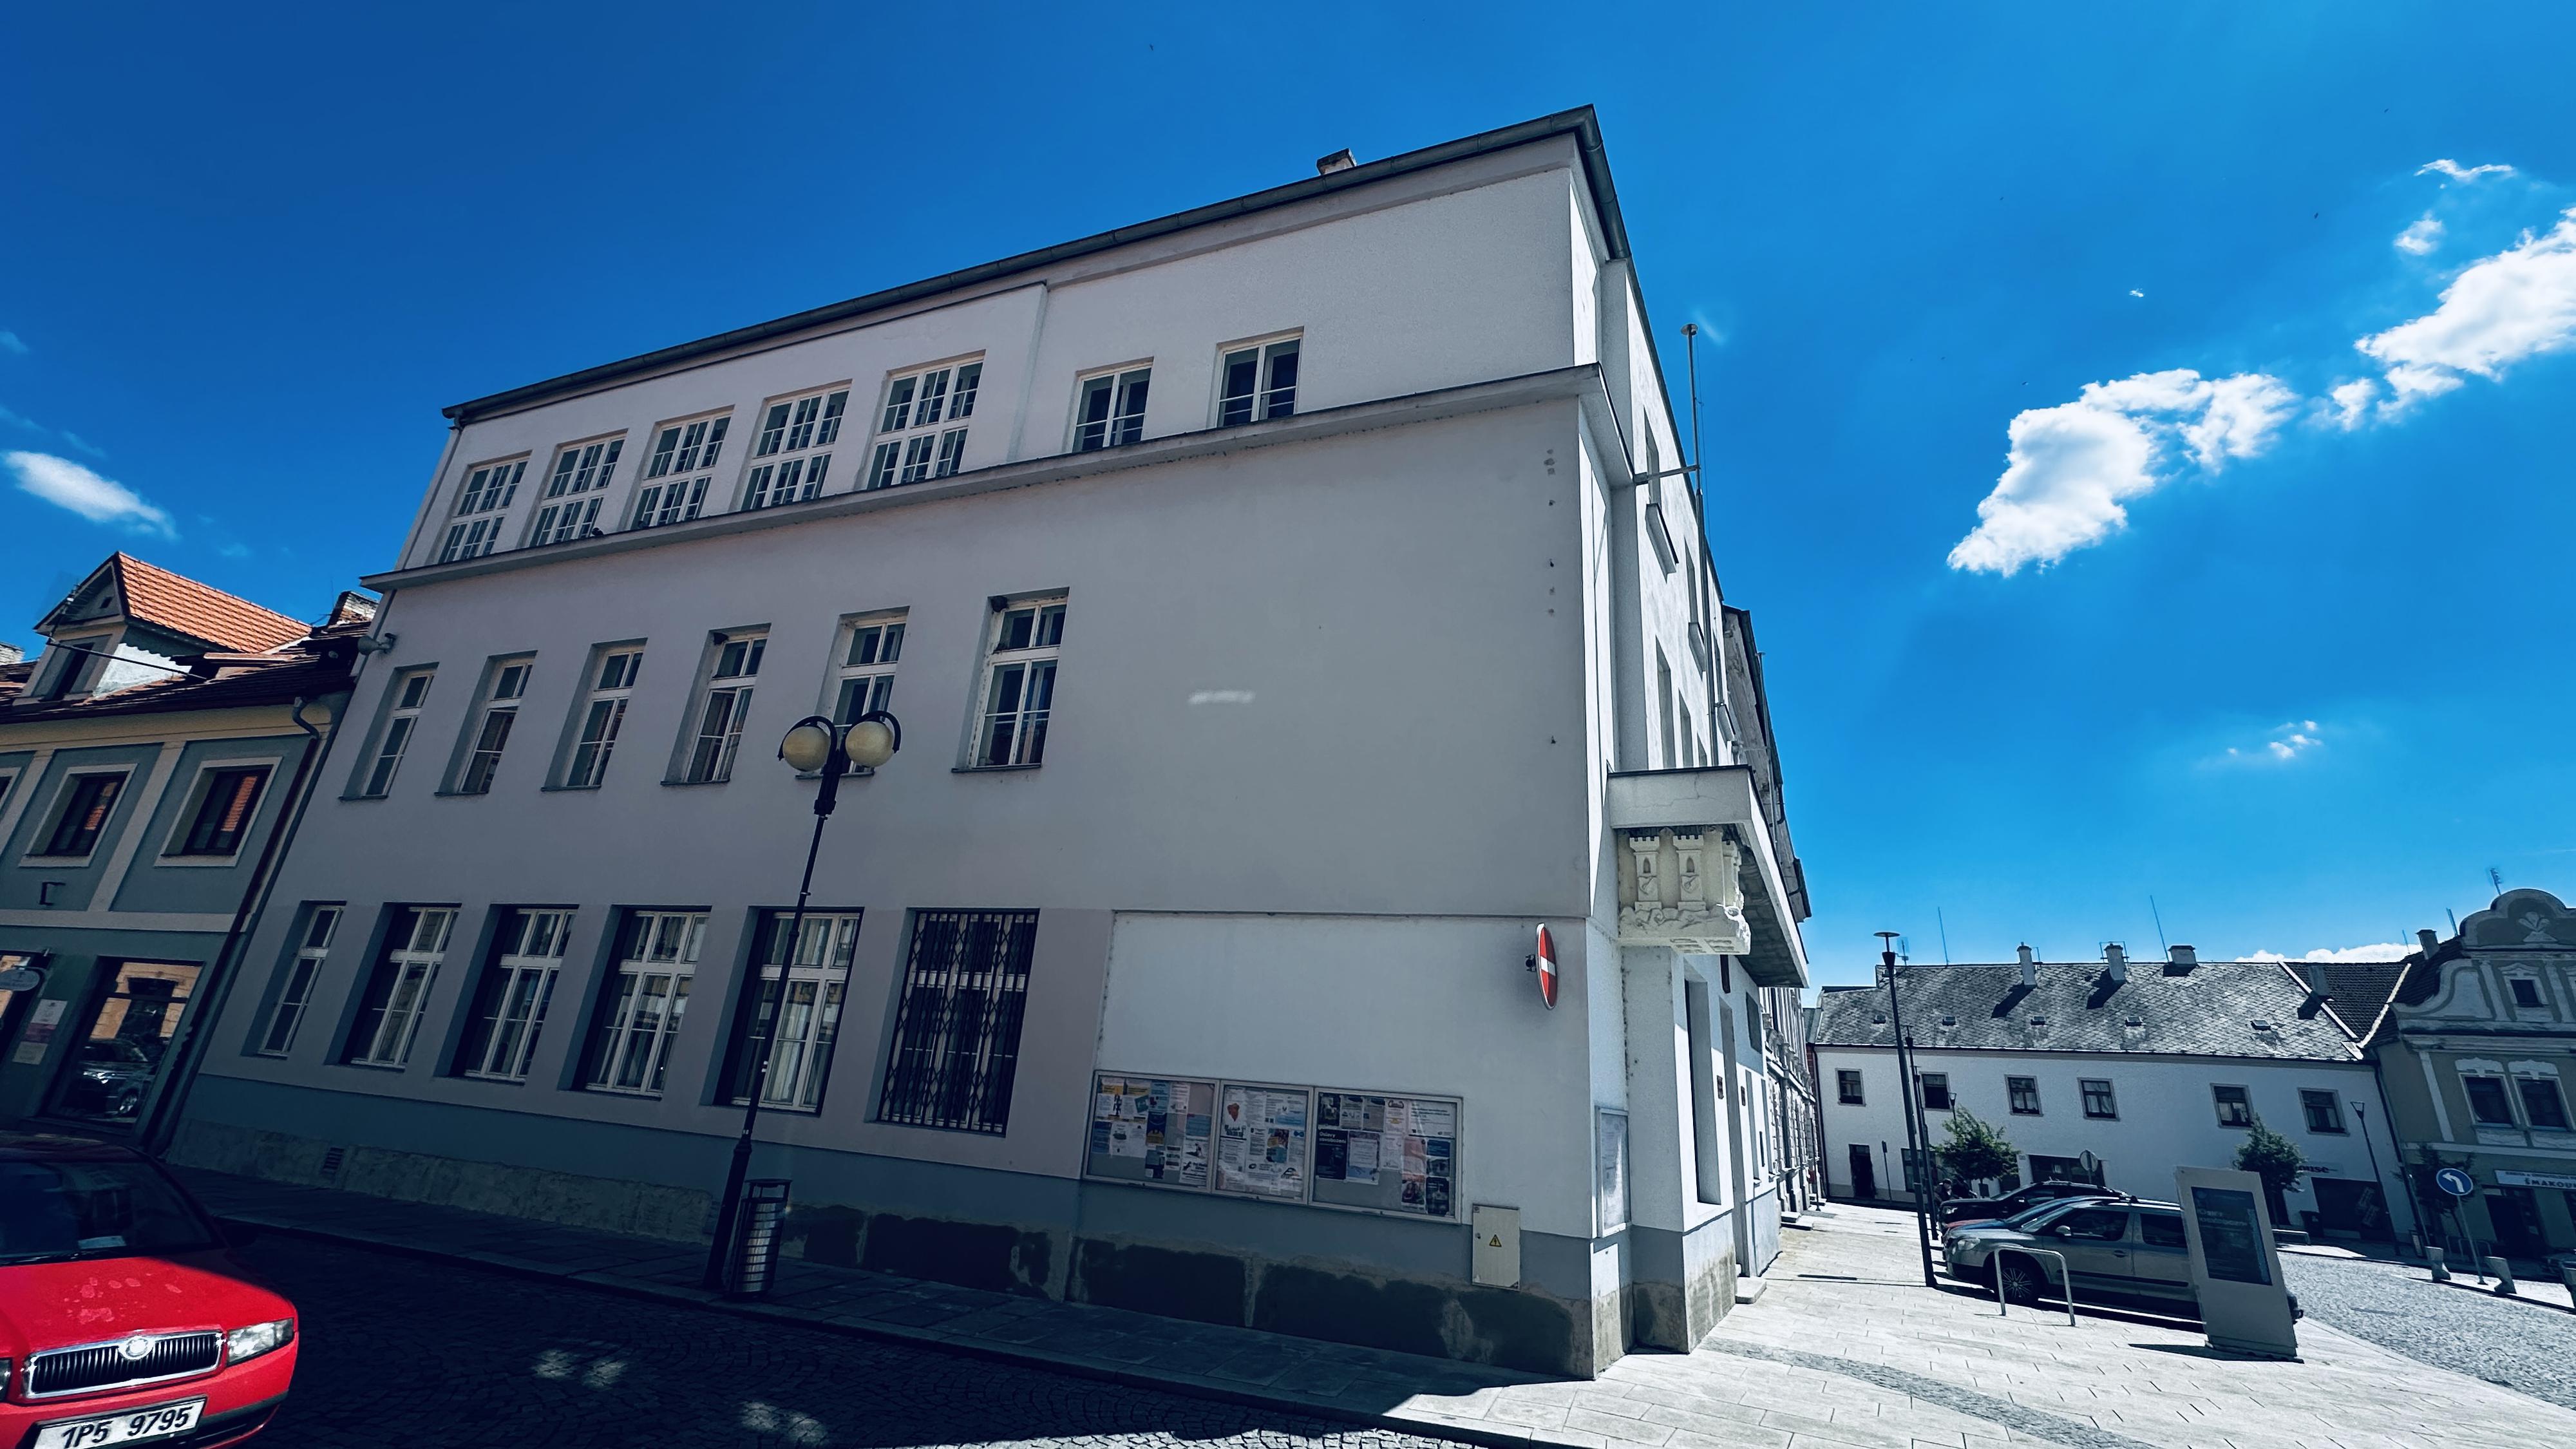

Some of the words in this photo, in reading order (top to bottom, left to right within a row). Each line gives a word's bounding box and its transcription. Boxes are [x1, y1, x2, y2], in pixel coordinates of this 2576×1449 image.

[2298, 1165, 2329, 1173] ouse
[62, 1421, 113, 1449] 1P5
[128, 1406, 193, 1435] 9795
